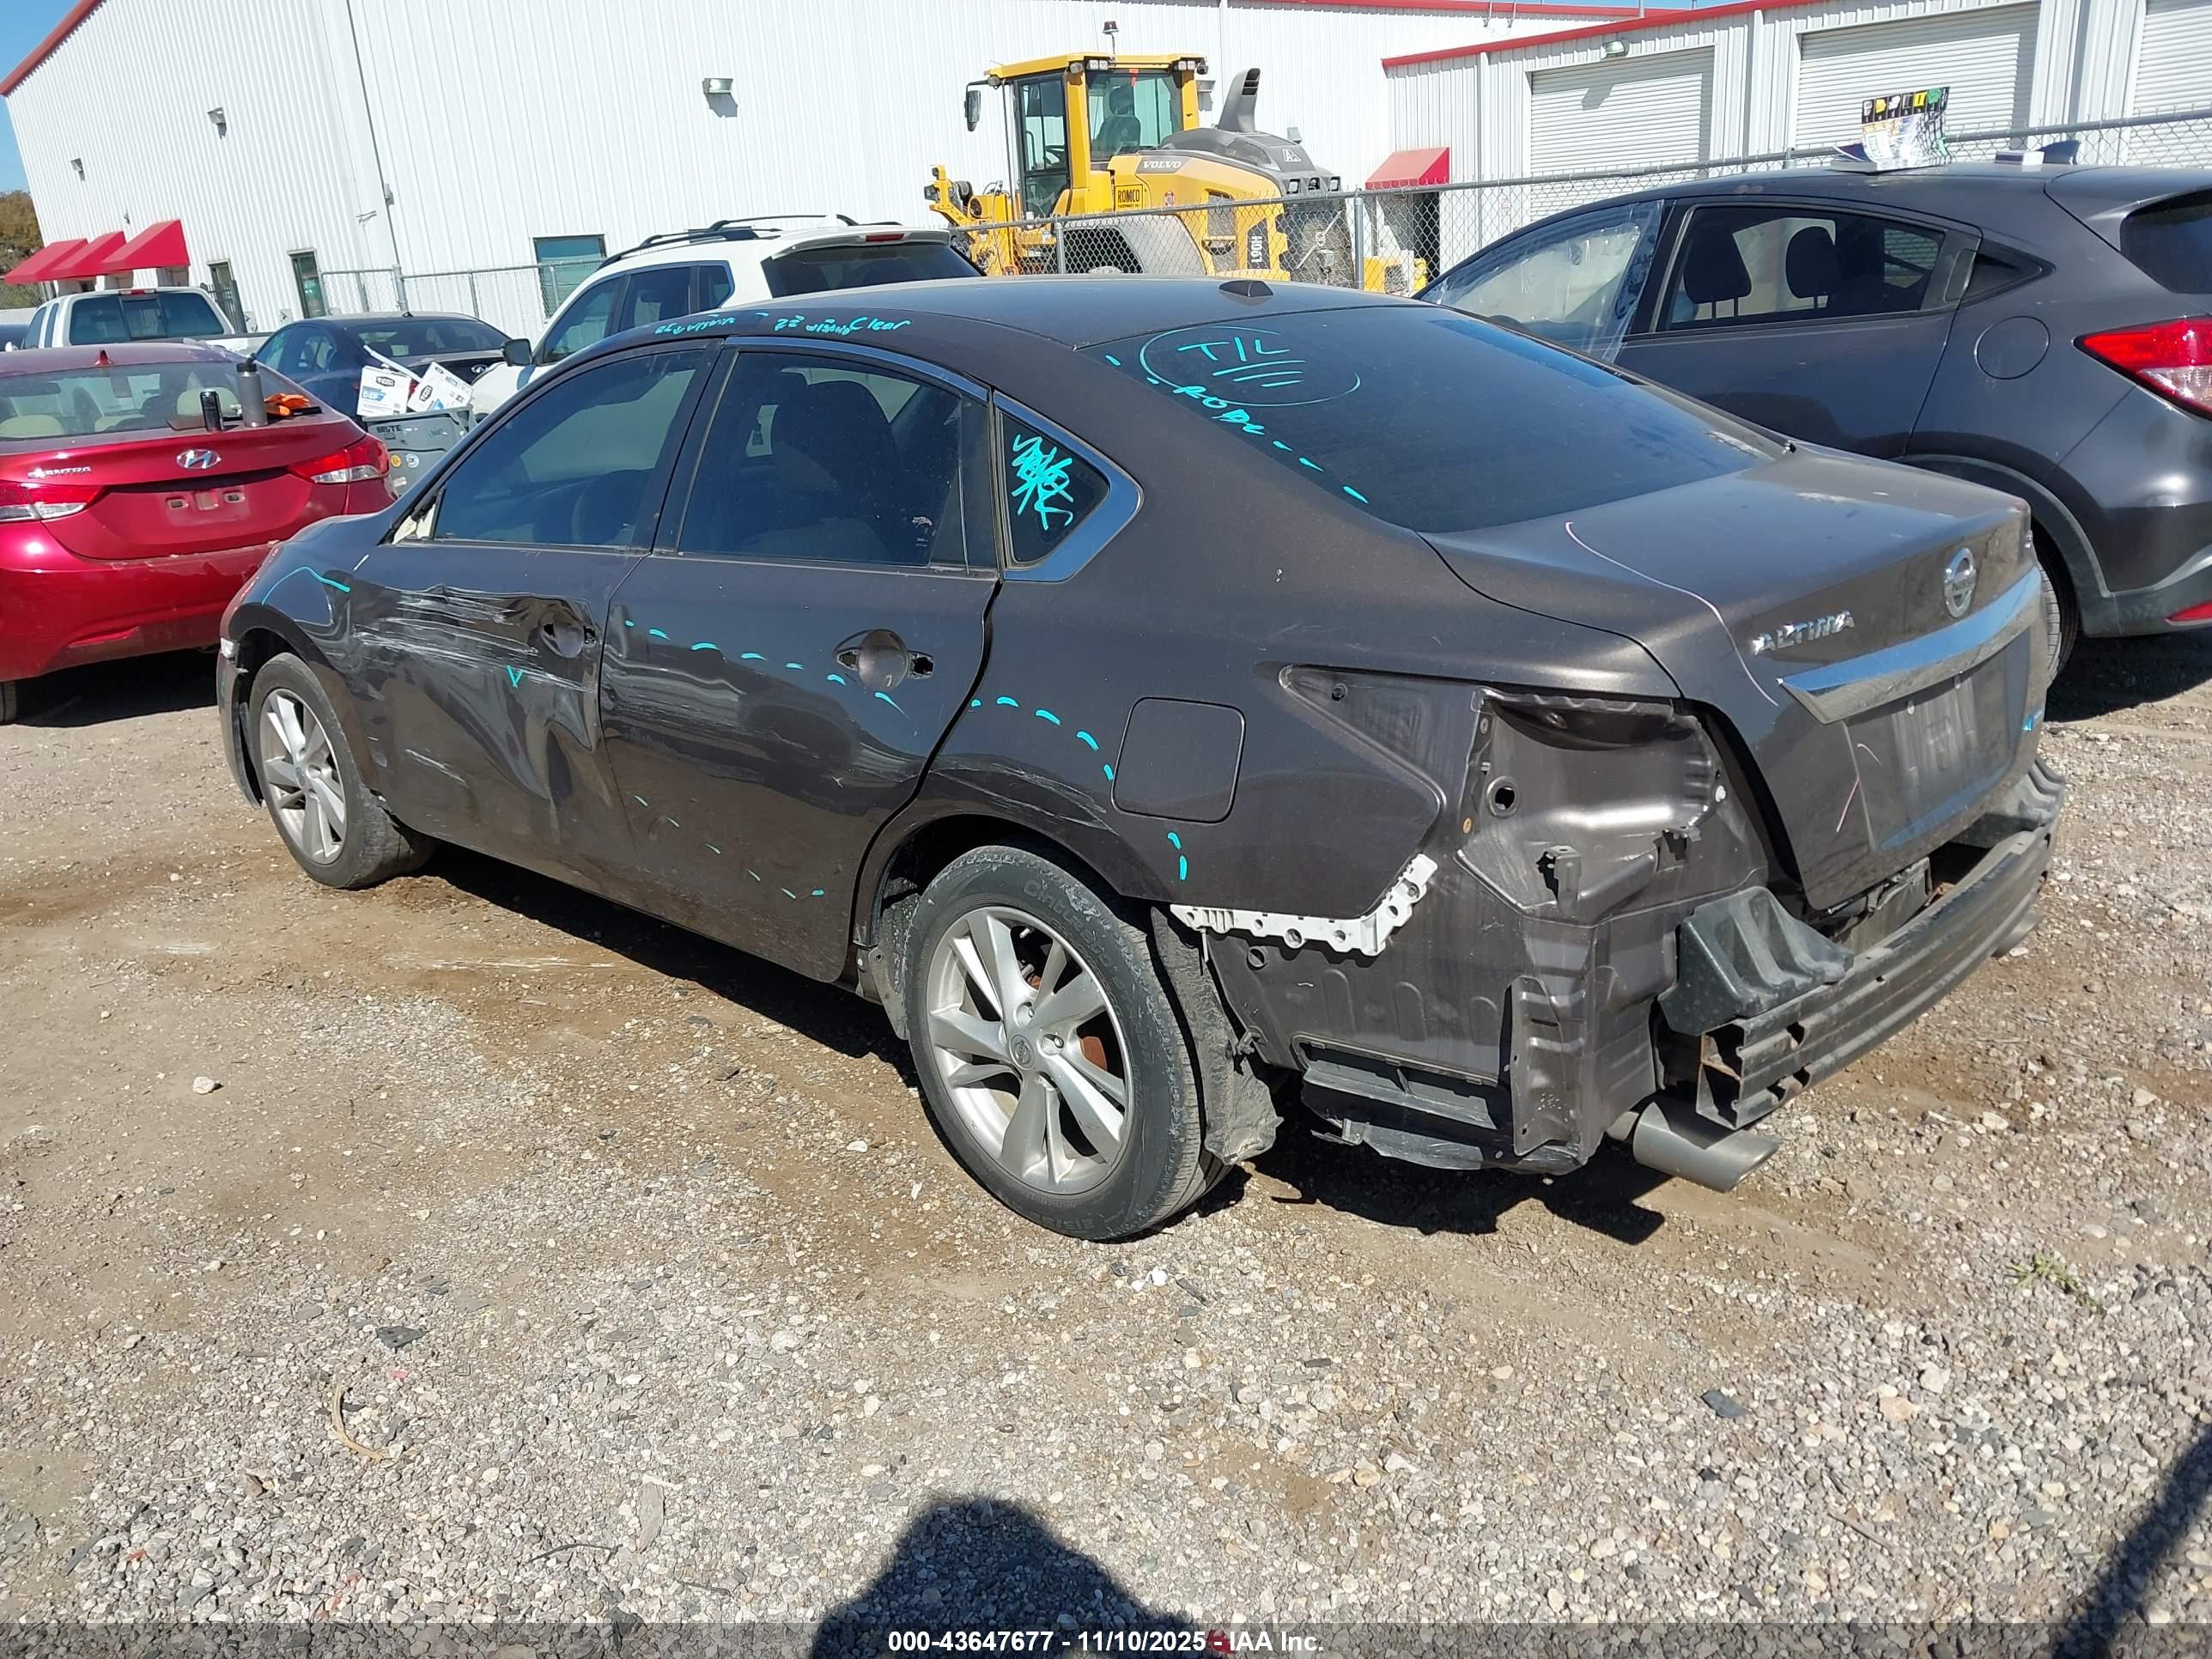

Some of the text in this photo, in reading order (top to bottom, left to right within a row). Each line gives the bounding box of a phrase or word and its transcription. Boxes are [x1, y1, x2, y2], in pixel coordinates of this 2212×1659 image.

[1117, 189, 1140, 203] ROMCO
[849, 316, 911, 332] Clear
[1752, 611, 1856, 656] ALTIMA
